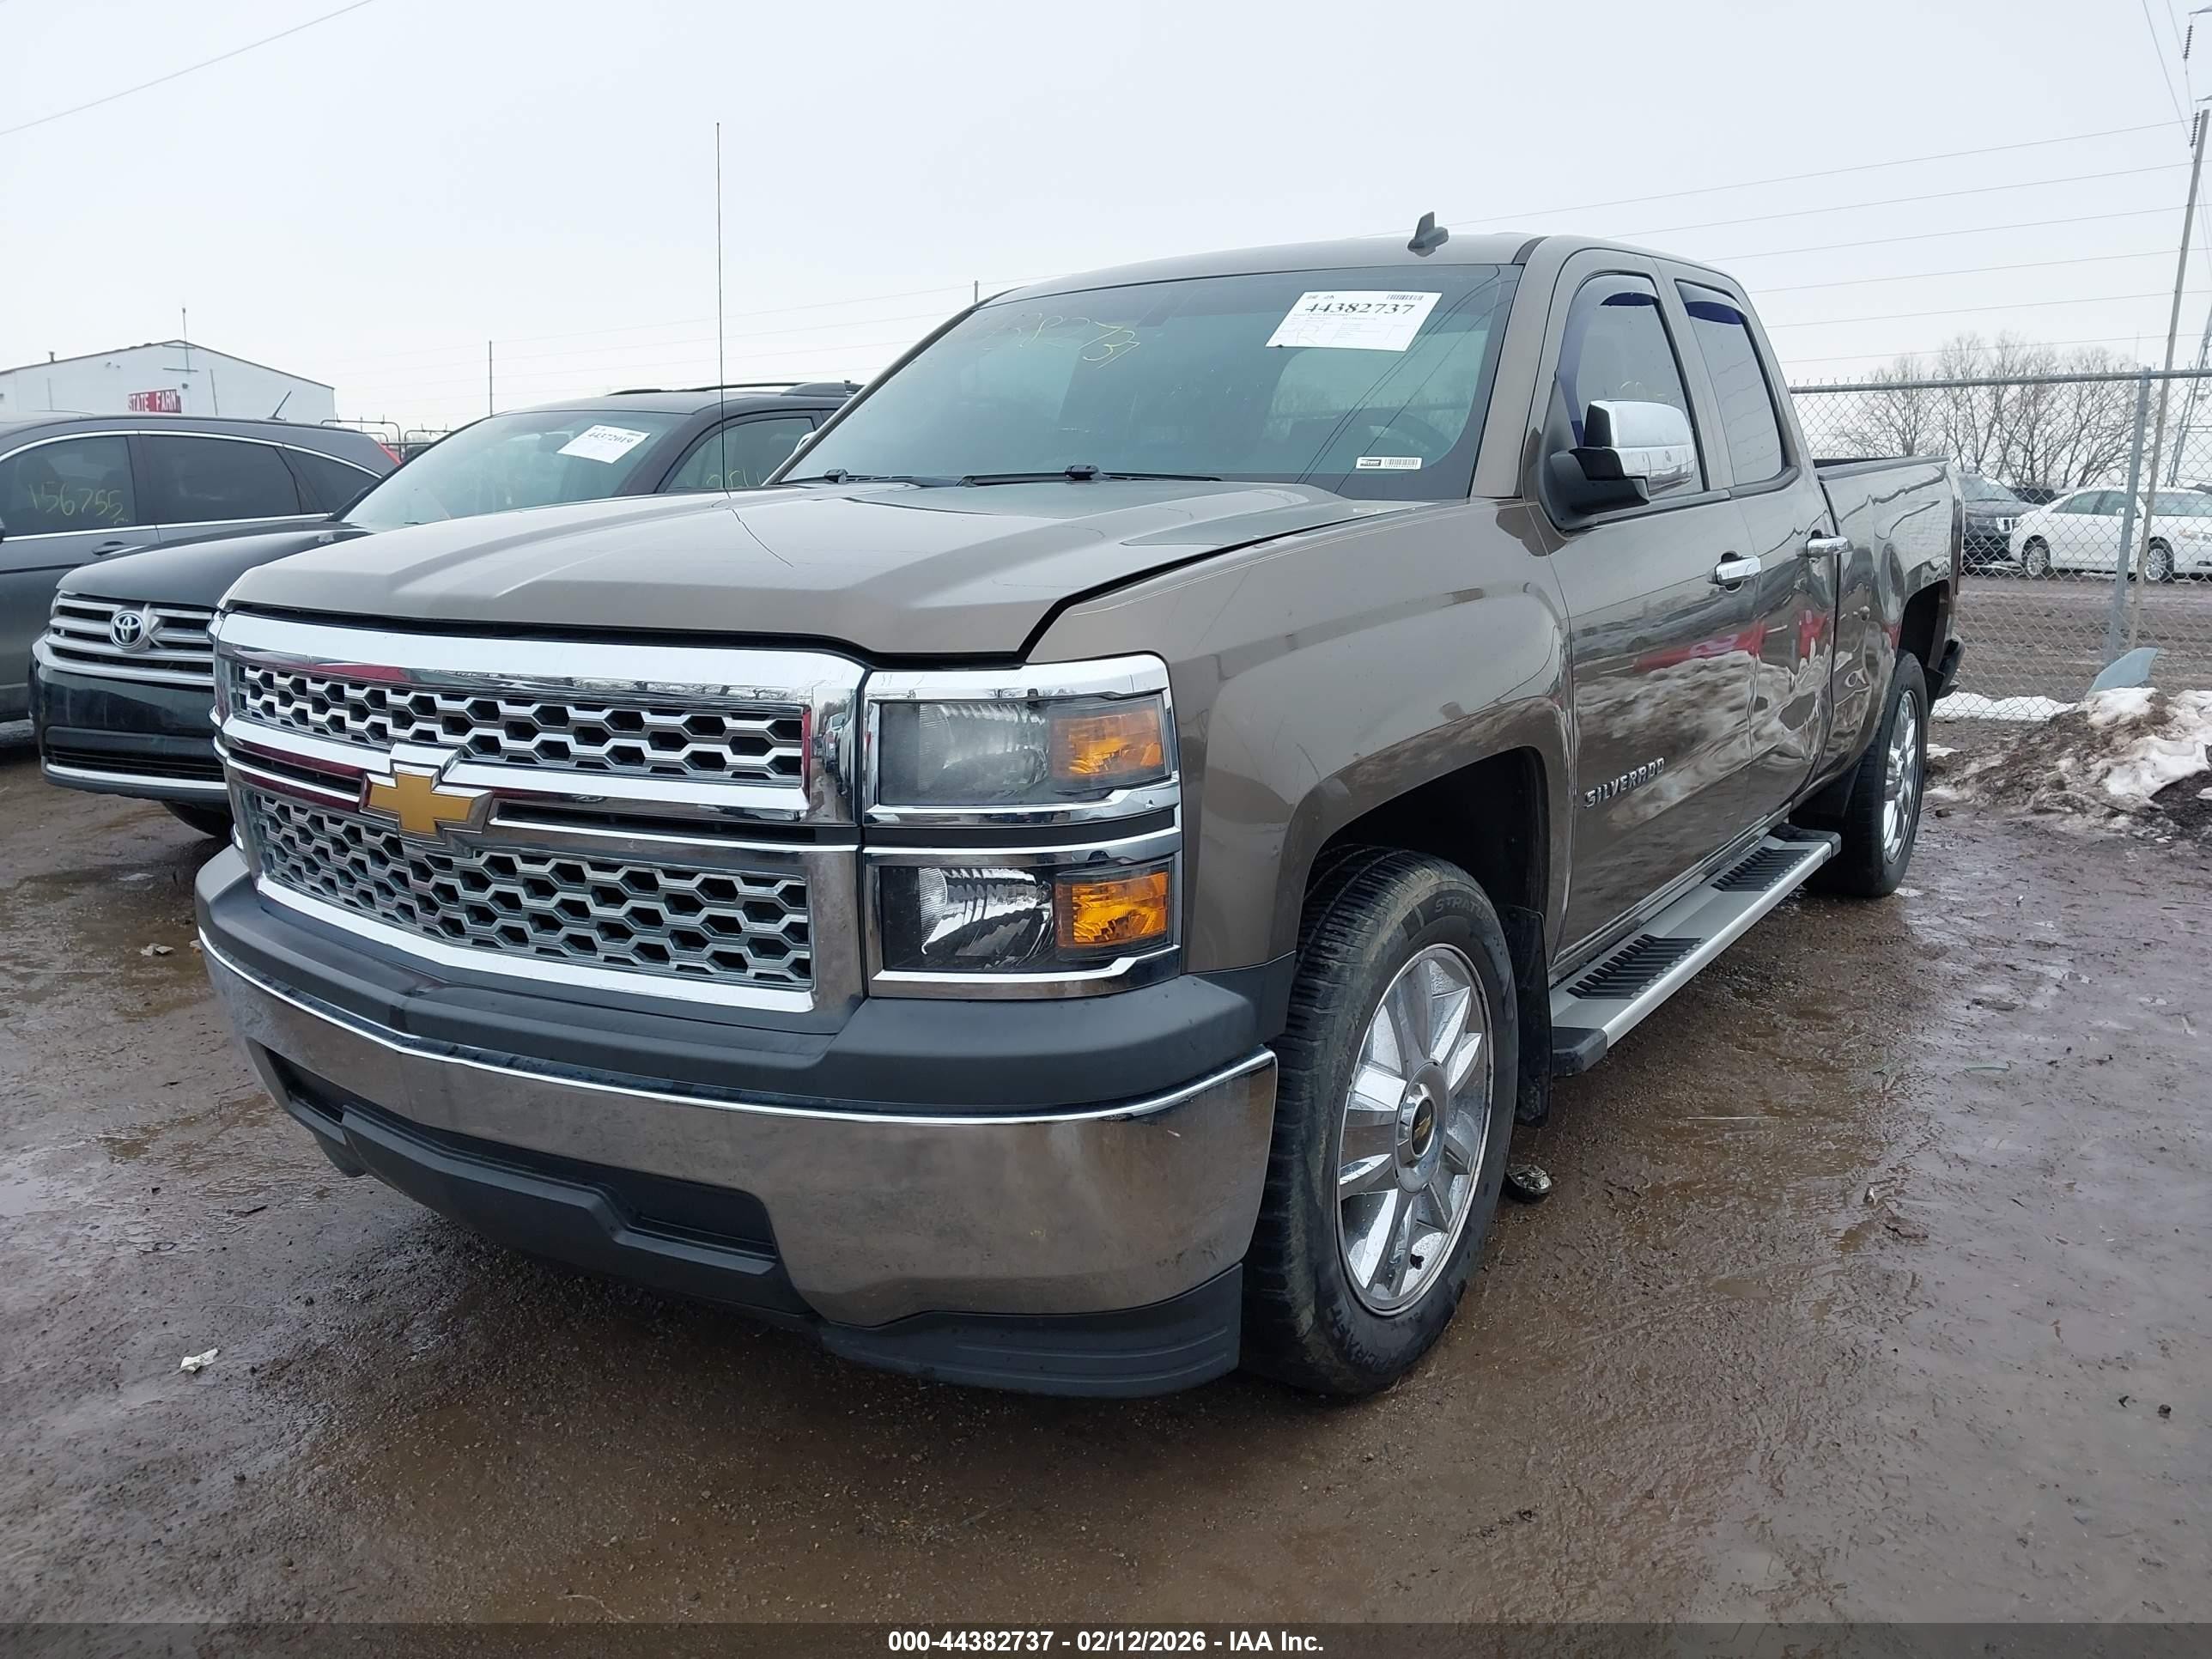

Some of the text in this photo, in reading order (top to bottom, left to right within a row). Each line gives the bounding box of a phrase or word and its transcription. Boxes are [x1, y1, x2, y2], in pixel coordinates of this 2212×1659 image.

[1304, 302, 1416, 315] 44382737
[129, 392, 150, 412] STATE
[27, 480, 125, 519] 156755
[1583, 757, 1666, 808] SILVERADO
